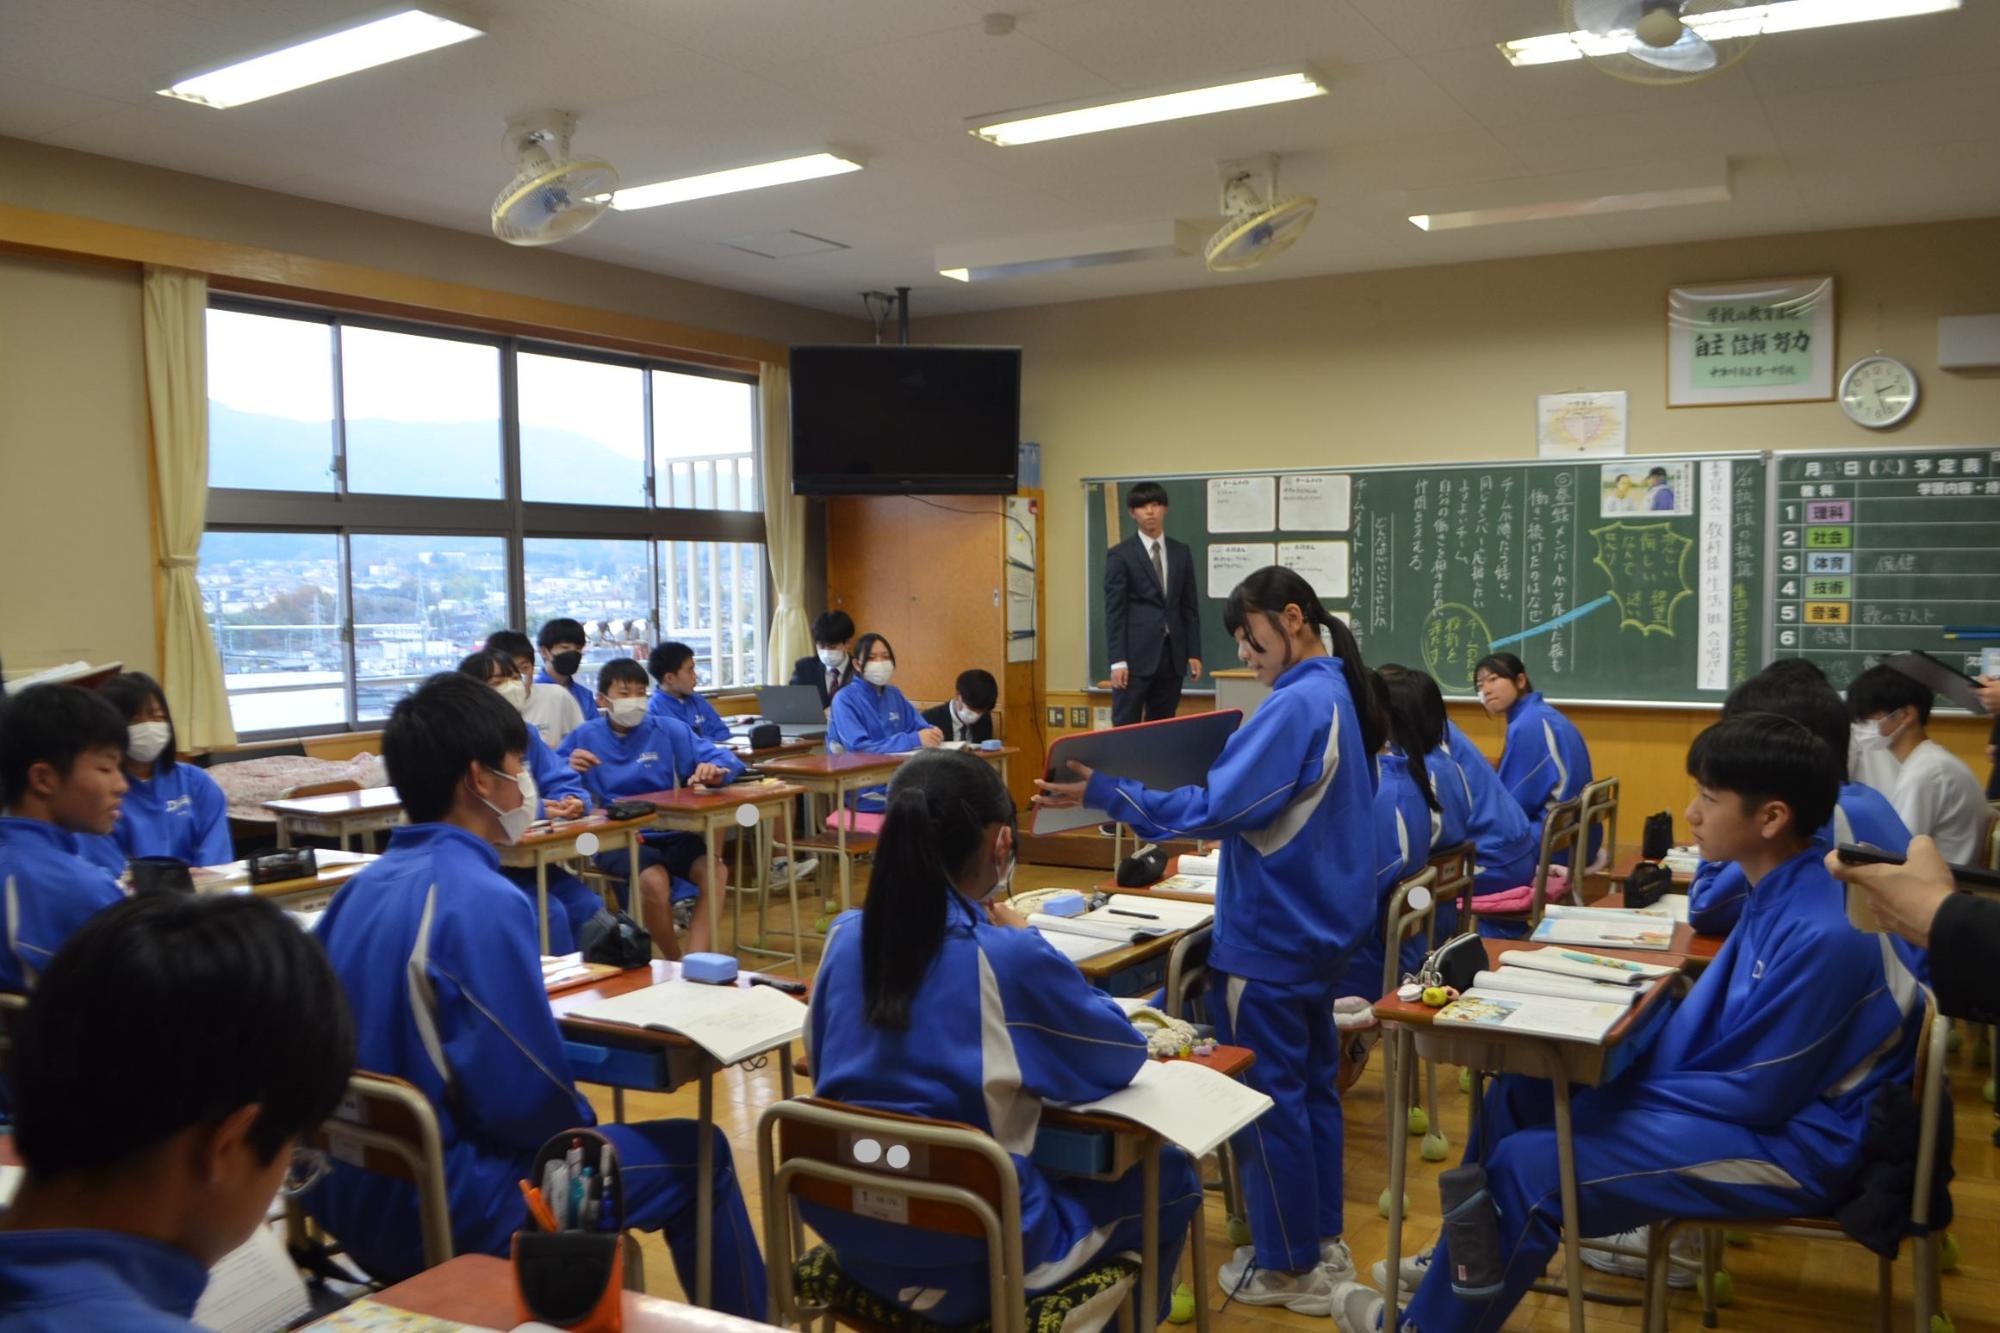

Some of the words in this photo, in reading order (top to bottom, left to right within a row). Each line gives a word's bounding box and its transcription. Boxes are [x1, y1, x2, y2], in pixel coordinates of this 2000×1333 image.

[1696, 333, 1724, 357] 自主
[1731, 332, 1767, 356] 信頼
[1772, 329, 1811, 354] 努力
[1785, 506, 1796, 520] 1
[1813, 505, 1844, 520] 理科
[1782, 531, 1797, 545] 2
[1813, 531, 1843, 545] 社会
[1782, 556, 1797, 570] 3
[1814, 556, 1844, 570] 体育
[1781, 580, 1796, 595] 4
[1813, 581, 1844, 595] 技術
[1780, 606, 1796, 620] 5
[1811, 606, 1841, 620] 音楽
[1780, 631, 1795, 645] 6
